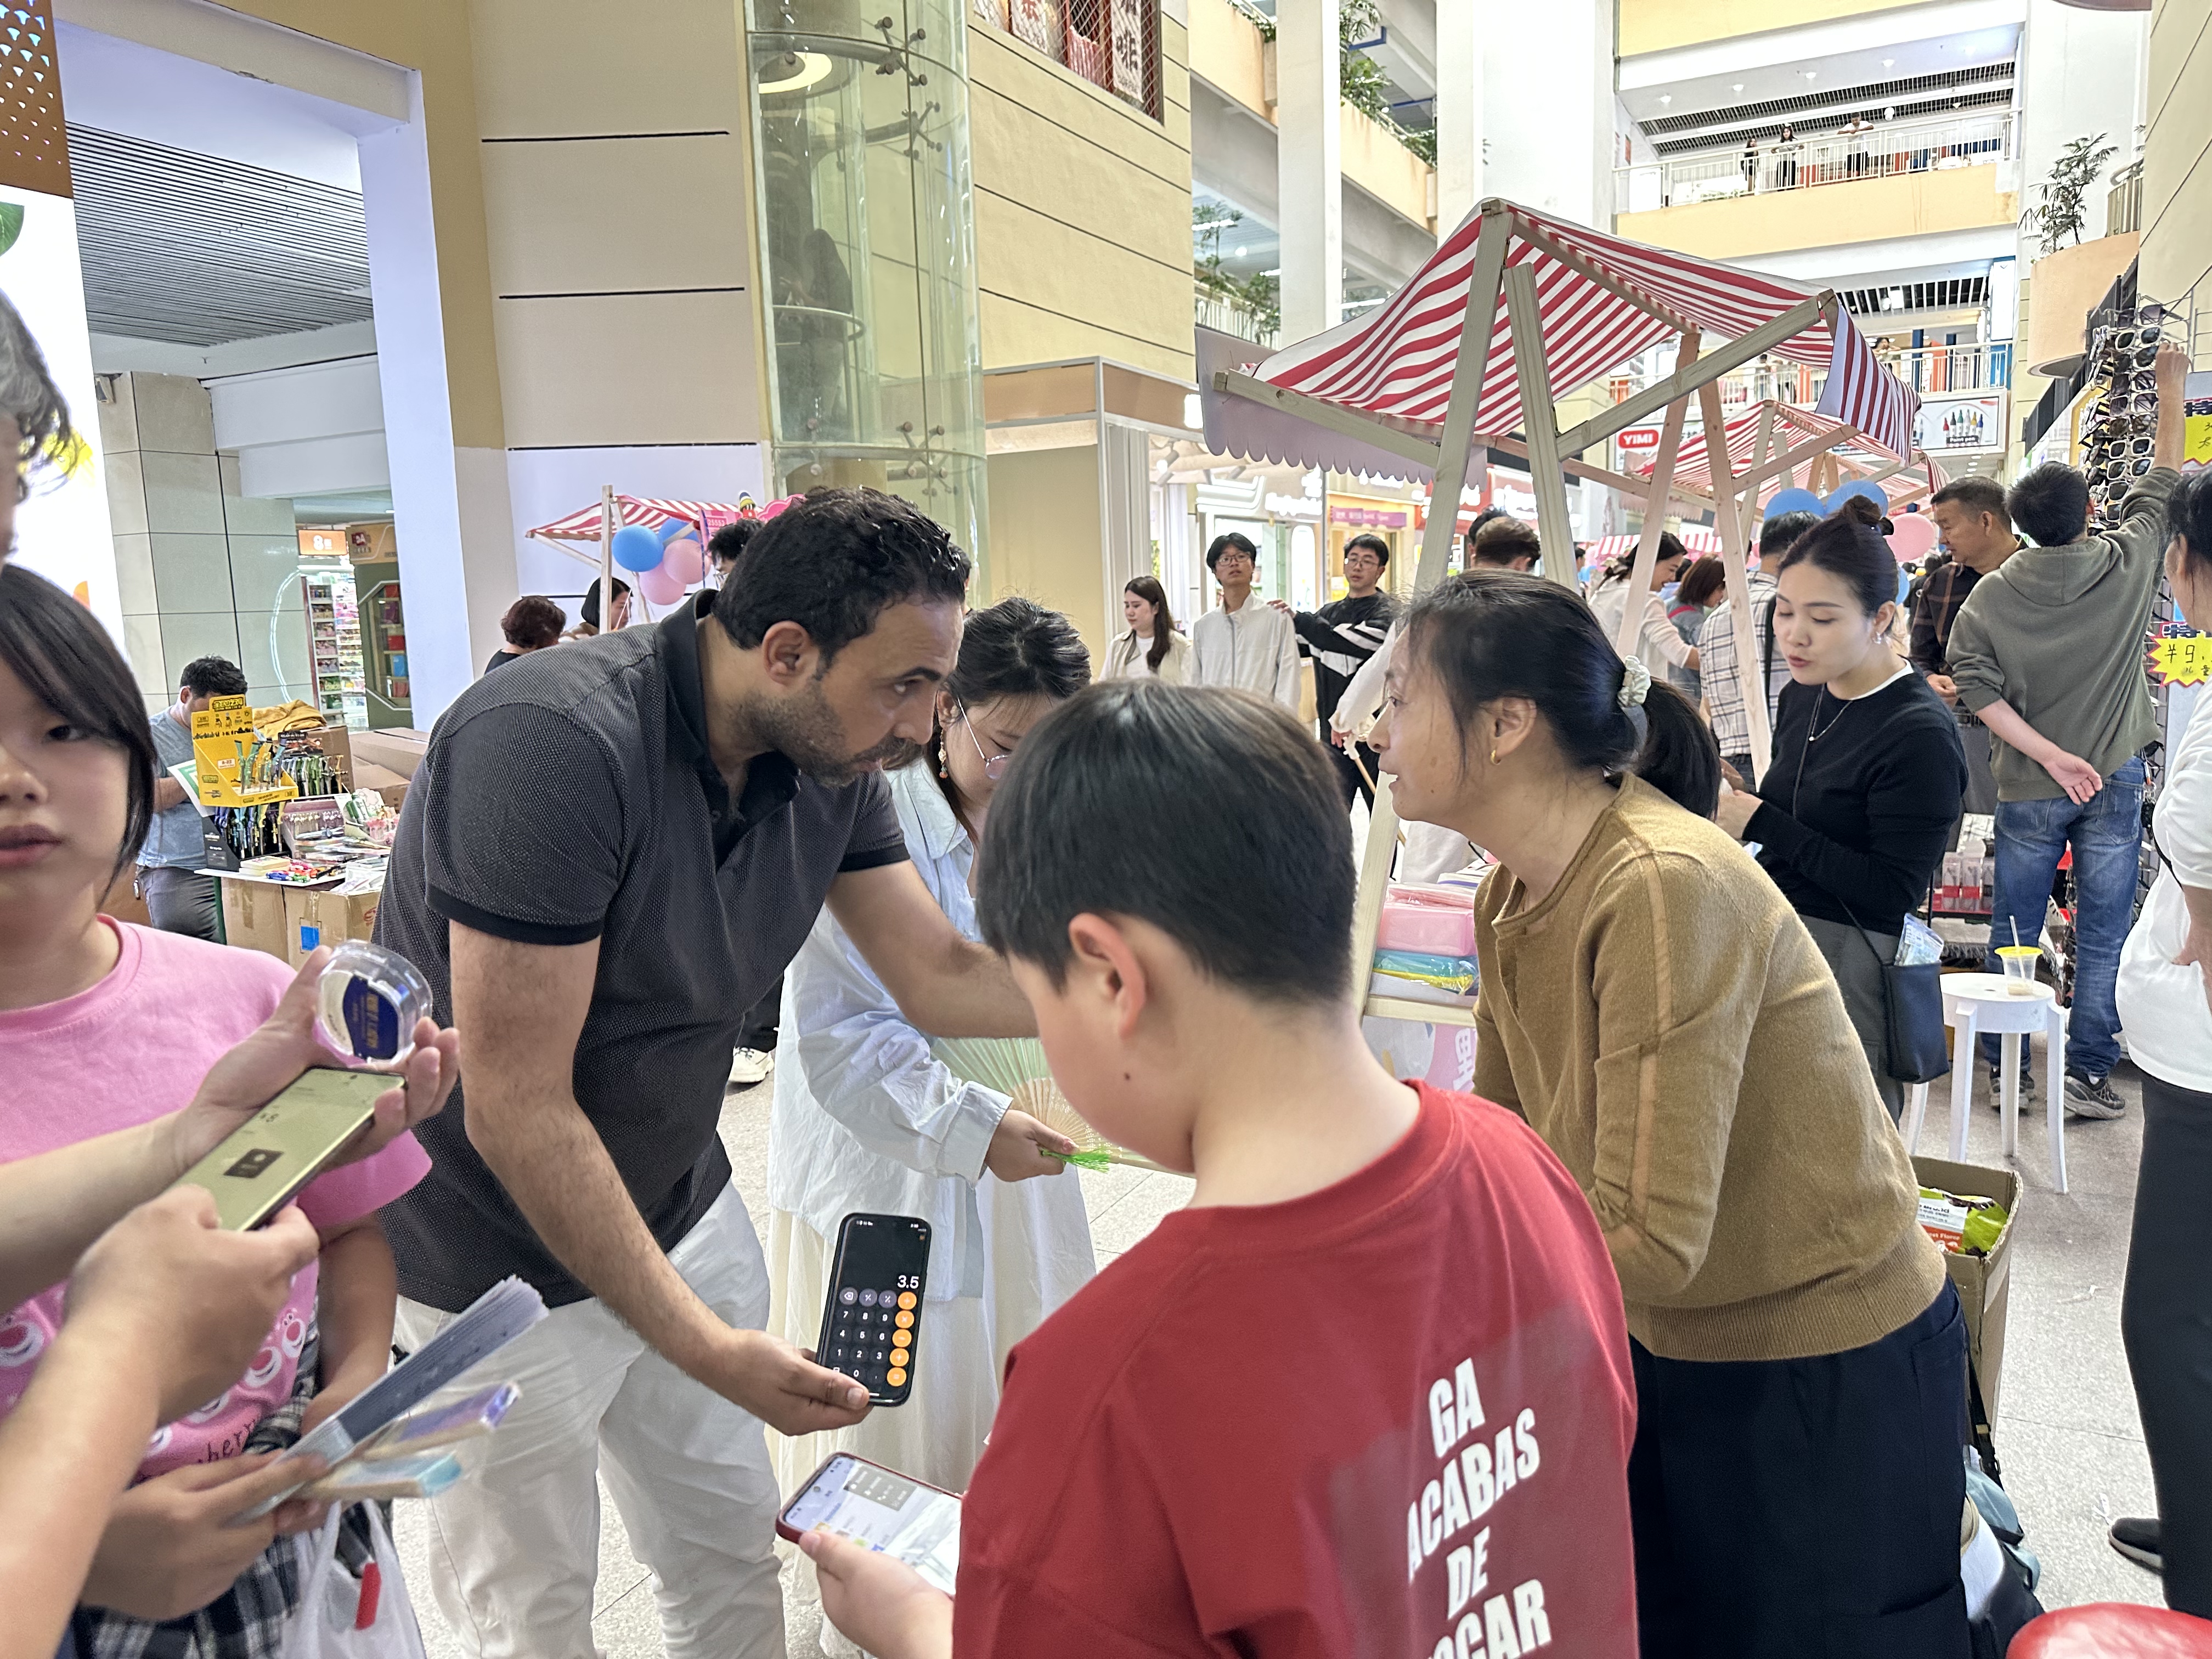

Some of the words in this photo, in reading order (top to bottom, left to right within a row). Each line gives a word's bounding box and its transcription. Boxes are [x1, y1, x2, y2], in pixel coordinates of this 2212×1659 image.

[1623, 433, 1654, 445] YIMI
[2164, 644, 2212, 663] ¥9.
[897, 1274, 919, 1289] 3.5
[843, 1311, 849, 1319] 7
[862, 1312, 868, 1321] 8
[882, 1314, 888, 1322] 9
[839, 1329, 845, 1338] 4
[859, 1331, 865, 1339] 5
[879, 1333, 885, 1341] 6
[837, 1348, 842, 1357] 1
[856, 1350, 862, 1358] 2
[876, 1351, 882, 1360] 3
[853, 1369, 860, 1378] 0
[1429, 1357, 1486, 1459] GA
[1407, 1408, 1541, 1586] ACABAS
[1446, 1526, 1491, 1621] DE
